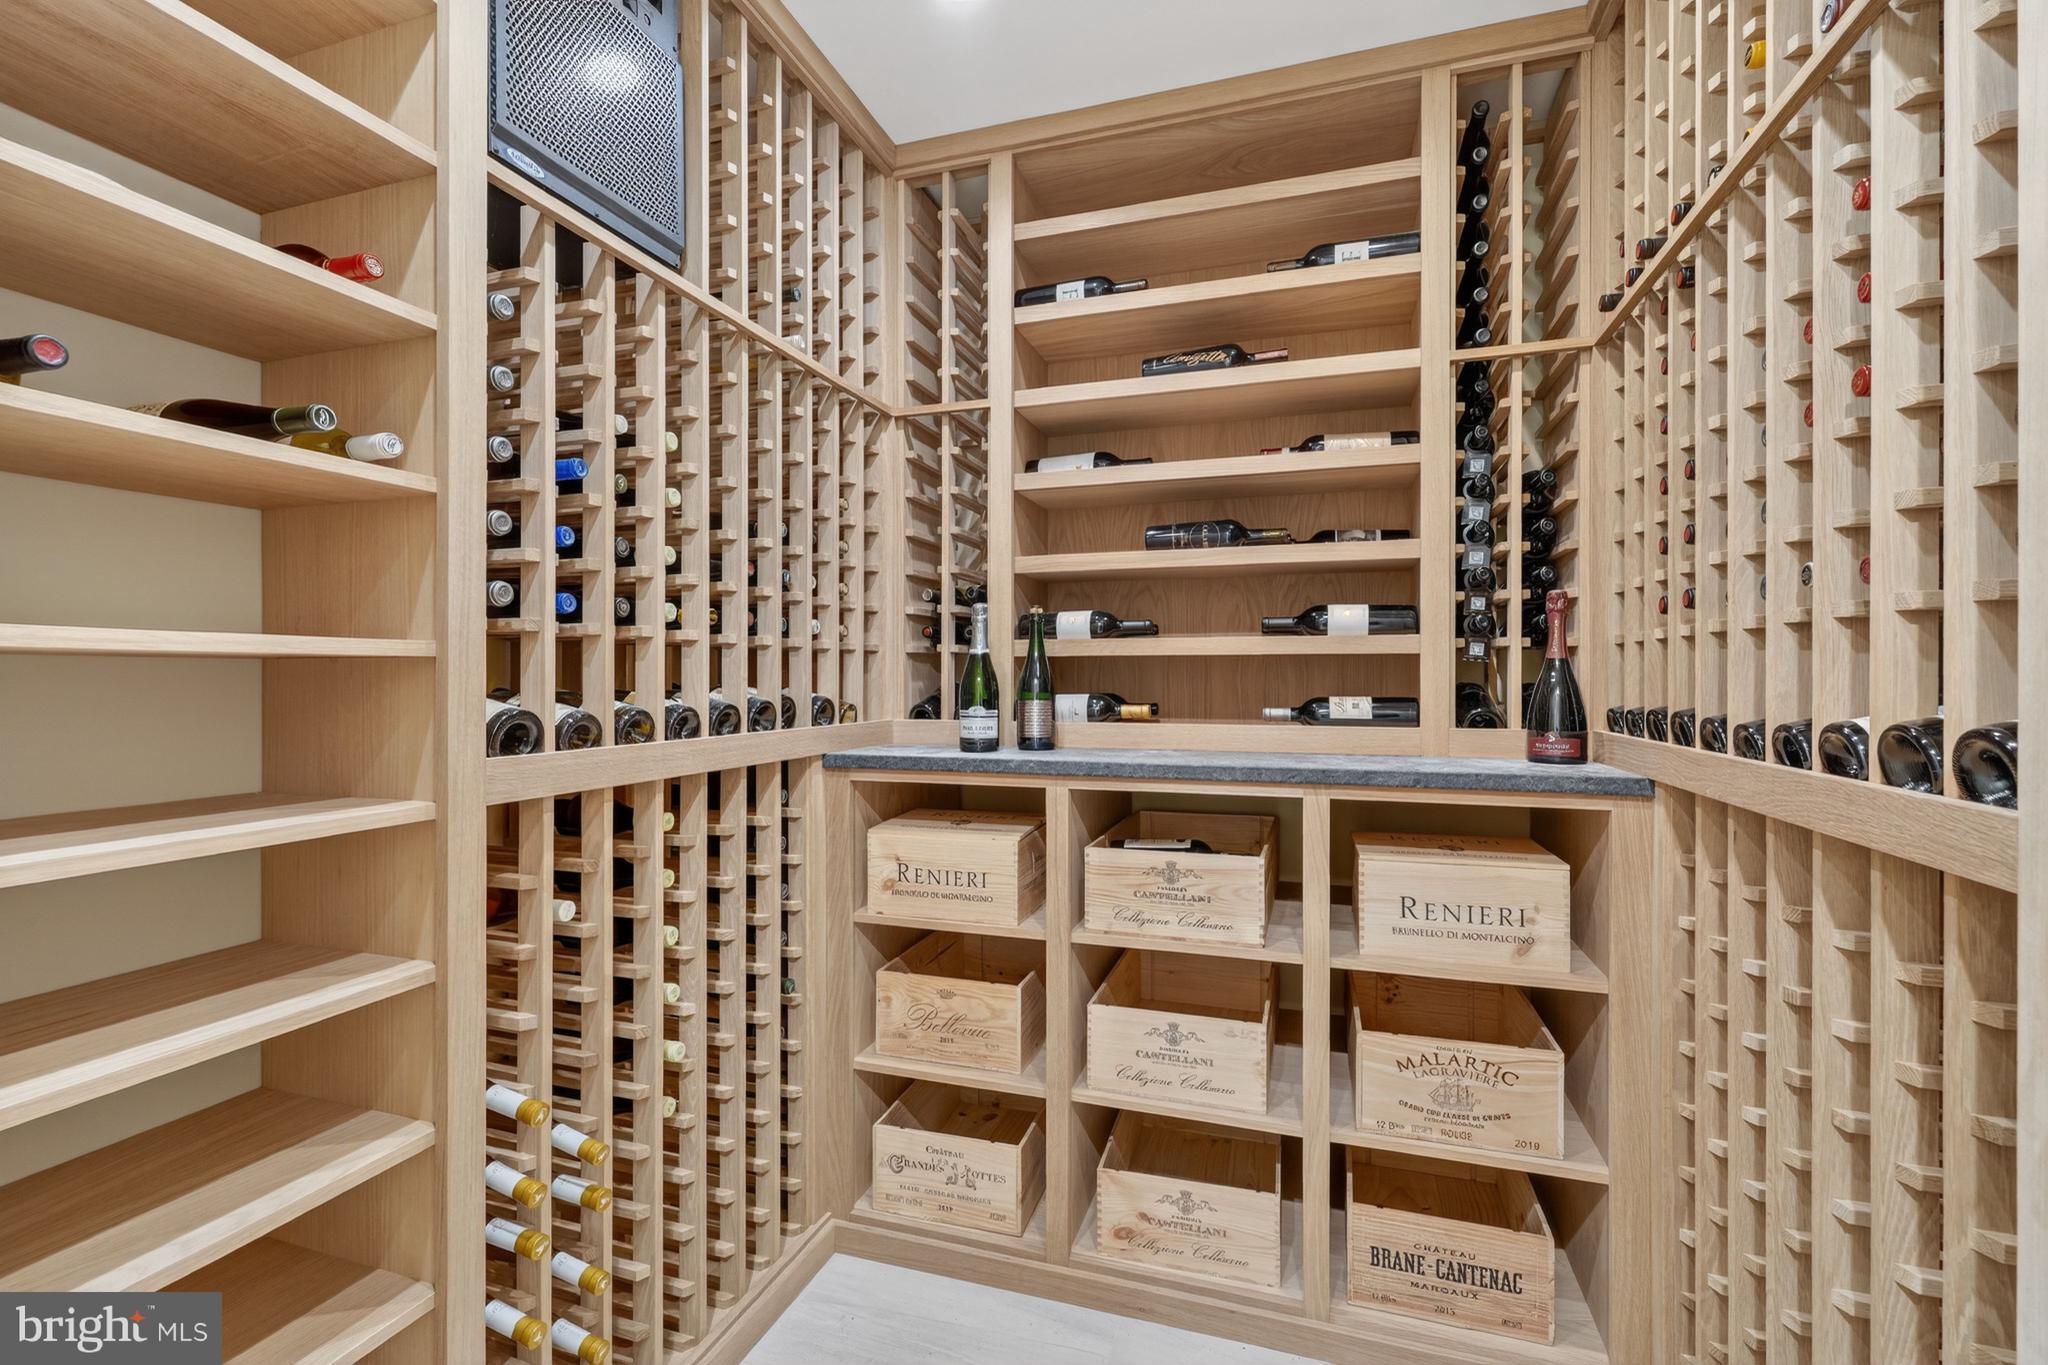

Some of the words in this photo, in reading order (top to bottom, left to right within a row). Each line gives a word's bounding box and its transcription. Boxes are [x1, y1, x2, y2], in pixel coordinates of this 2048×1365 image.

[897, 862, 987, 889] RENIERI
[1400, 896, 1526, 927] RENIERI
[1392, 926, 1444, 938] BRUNELLO
[1447, 930, 1459, 940] DI
[1460, 932, 1535, 945] MONTALCINO
[1115, 1064, 1173, 1087] Collezione
[1396, 1052, 1519, 1087] MALARTIC
[1410, 1281, 1479, 1300] MARGAUX
